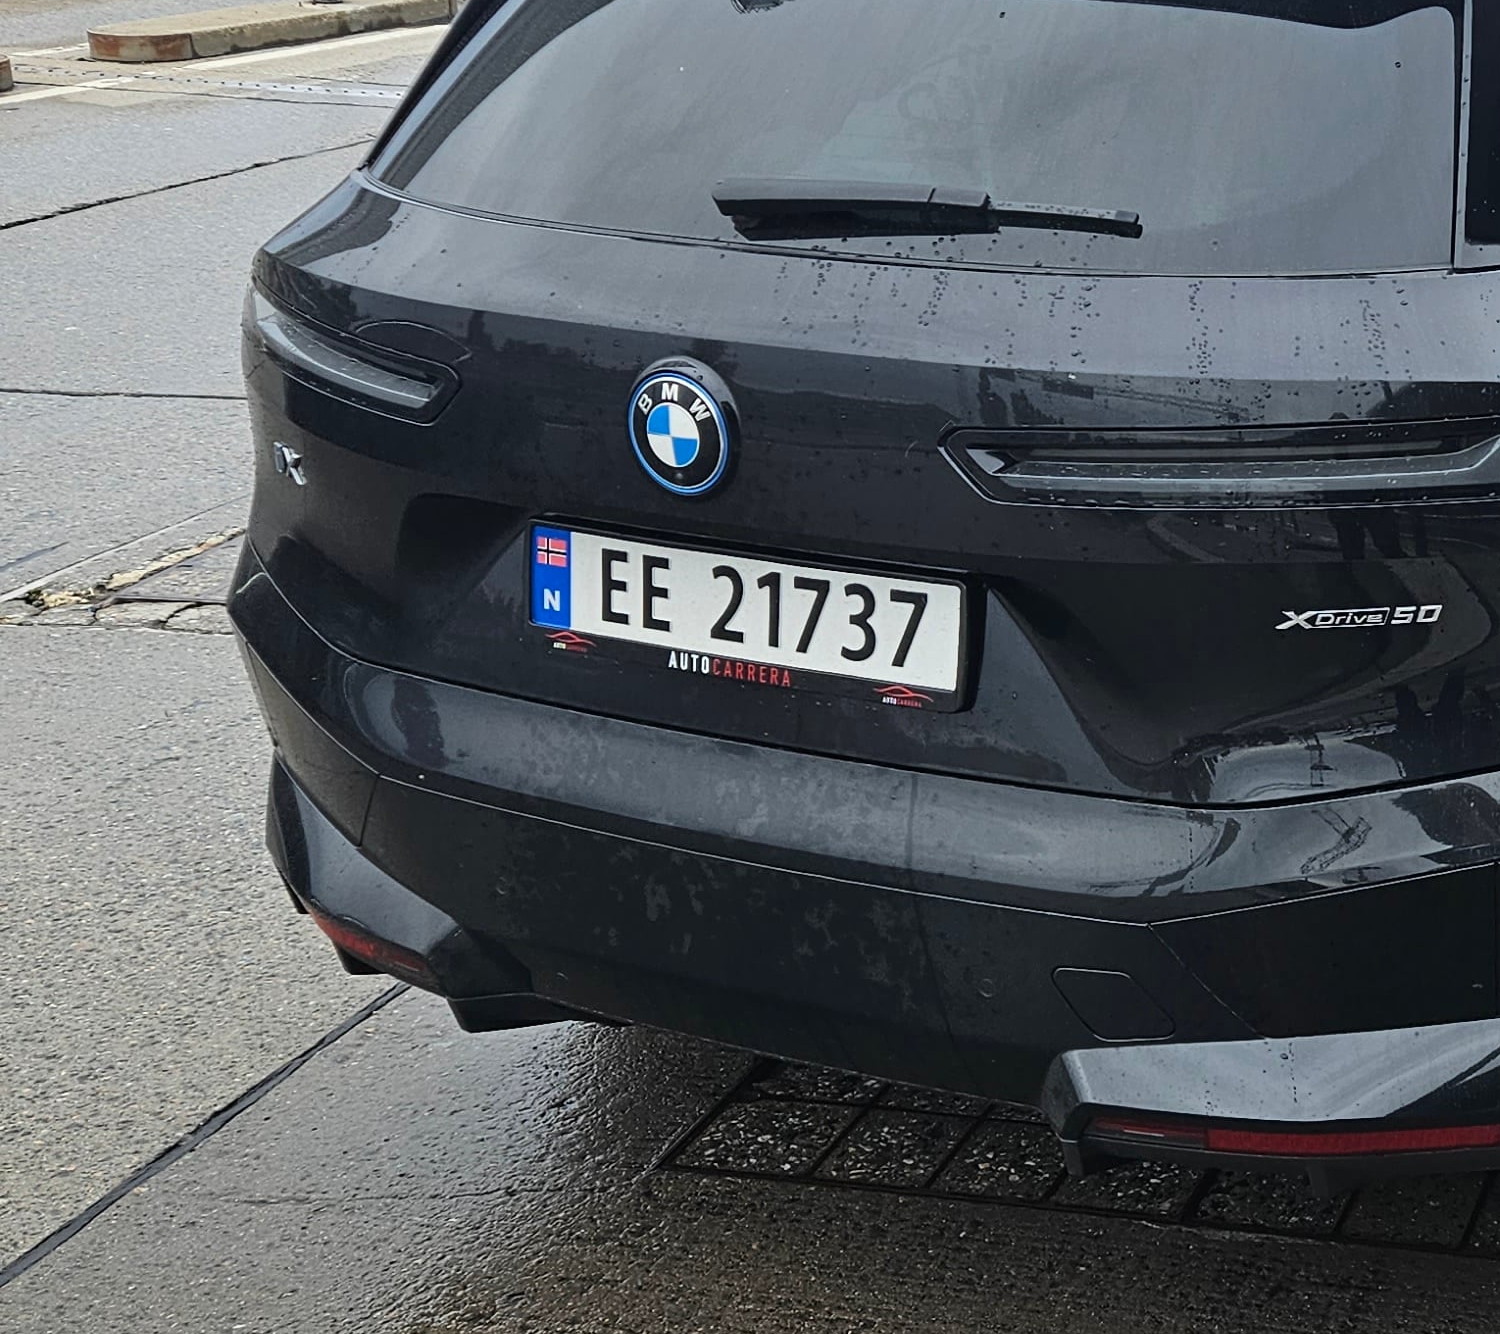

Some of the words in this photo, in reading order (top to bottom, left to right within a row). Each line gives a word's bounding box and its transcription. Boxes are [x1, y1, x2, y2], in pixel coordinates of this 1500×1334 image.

[638, 382, 711, 422] BMW
[543, 588, 560, 612] N
[601, 548, 670, 633] EE
[710, 565, 928, 668] 21737
[1391, 604, 1443, 625] 50
